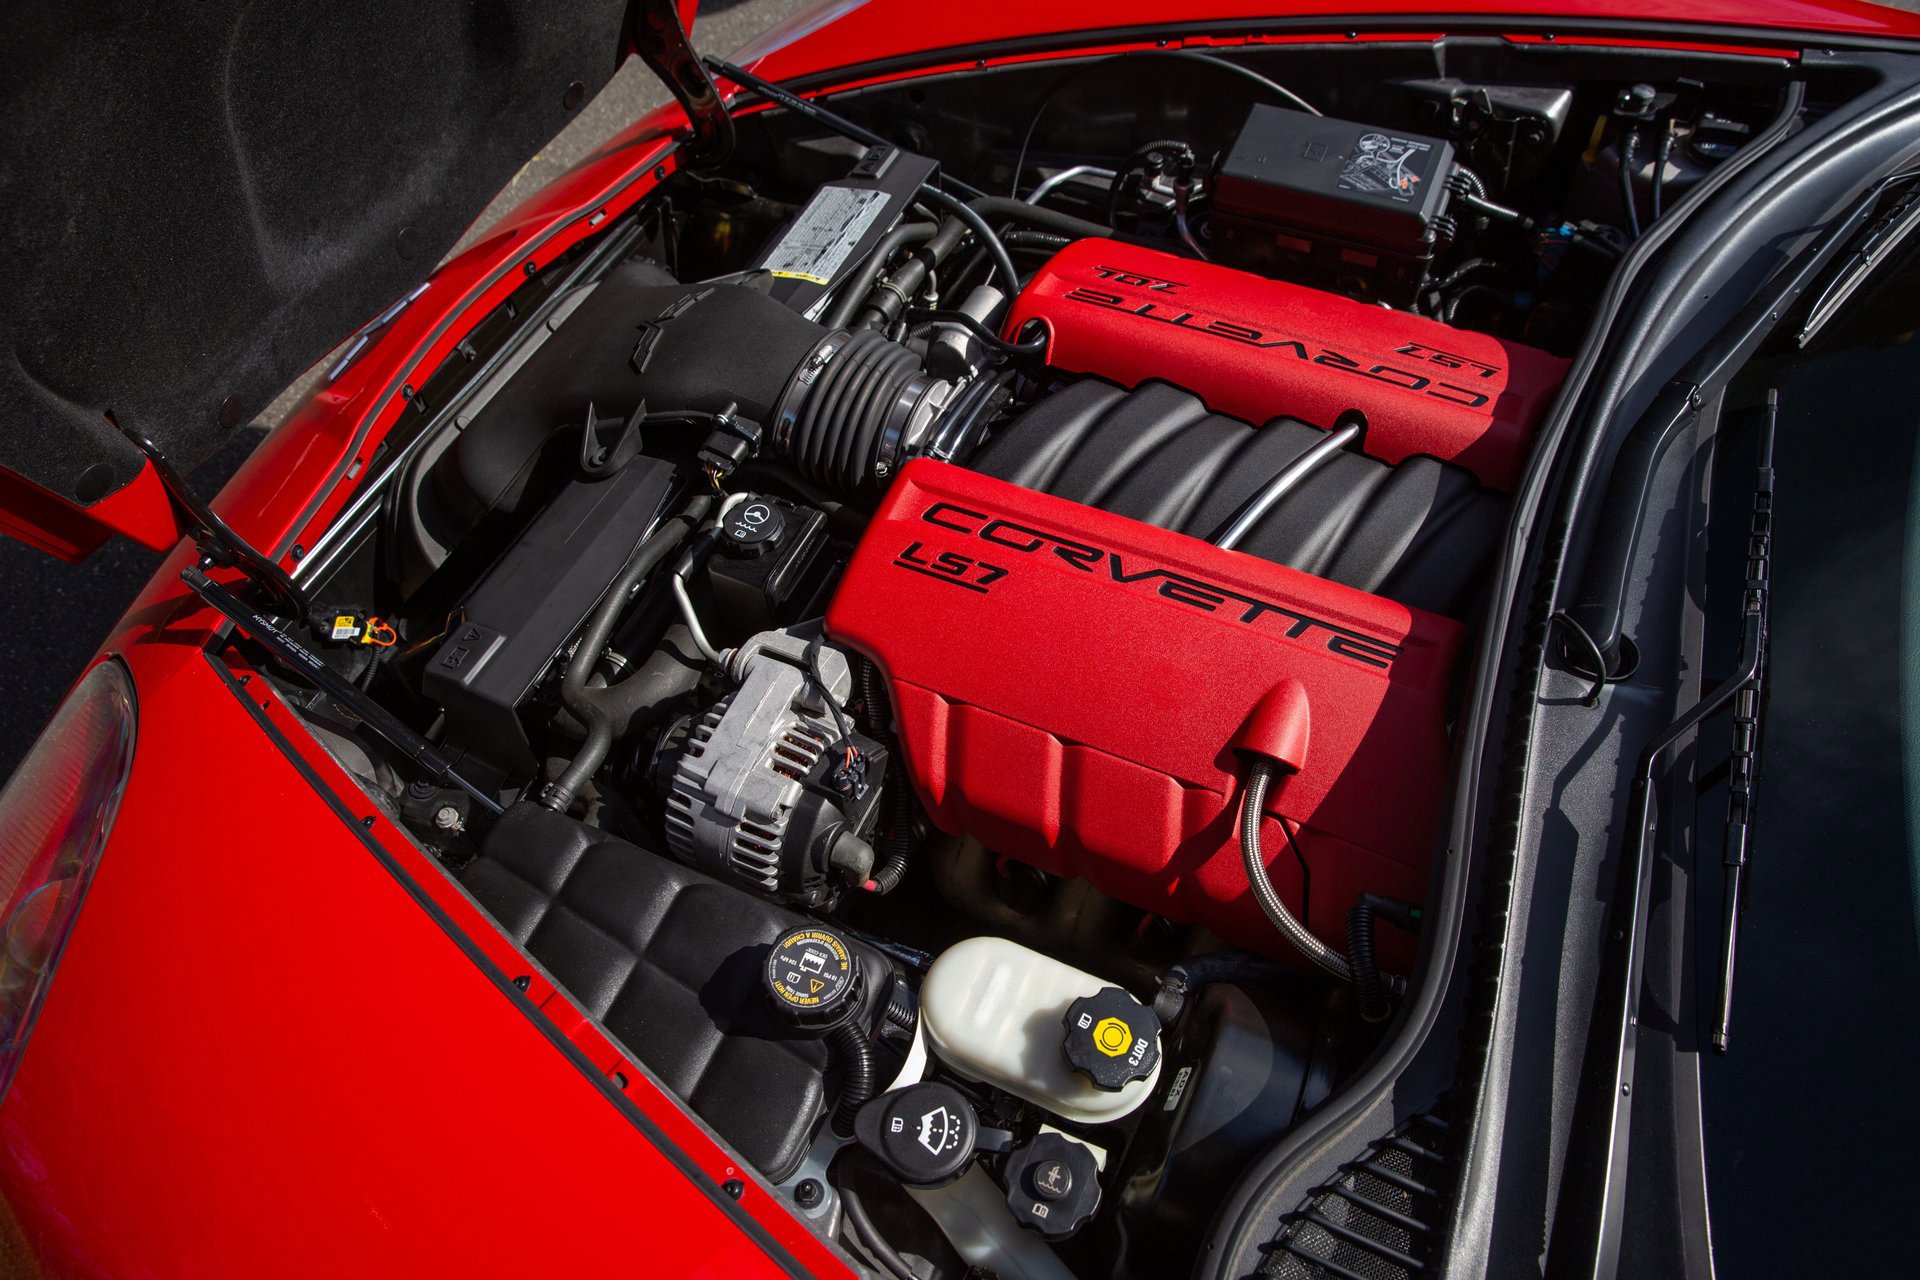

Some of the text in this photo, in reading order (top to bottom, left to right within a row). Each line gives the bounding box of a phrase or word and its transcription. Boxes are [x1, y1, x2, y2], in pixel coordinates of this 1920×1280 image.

[1063, 288, 1489, 407] CORVETTE
[1393, 343, 1500, 378] LS7
[894, 541, 1009, 590] LS7
[921, 502, 1404, 669] CORVETTE
[783, 933, 805, 949] CHAUD!
[811, 932, 834, 944] OUVRIR
[831, 941, 847, 961] JAMAIS
[840, 961, 848, 971] NE
[774, 980, 819, 1004] NEVER OPEN HOT!
[1128, 1038, 1148, 1066] DOT 3
